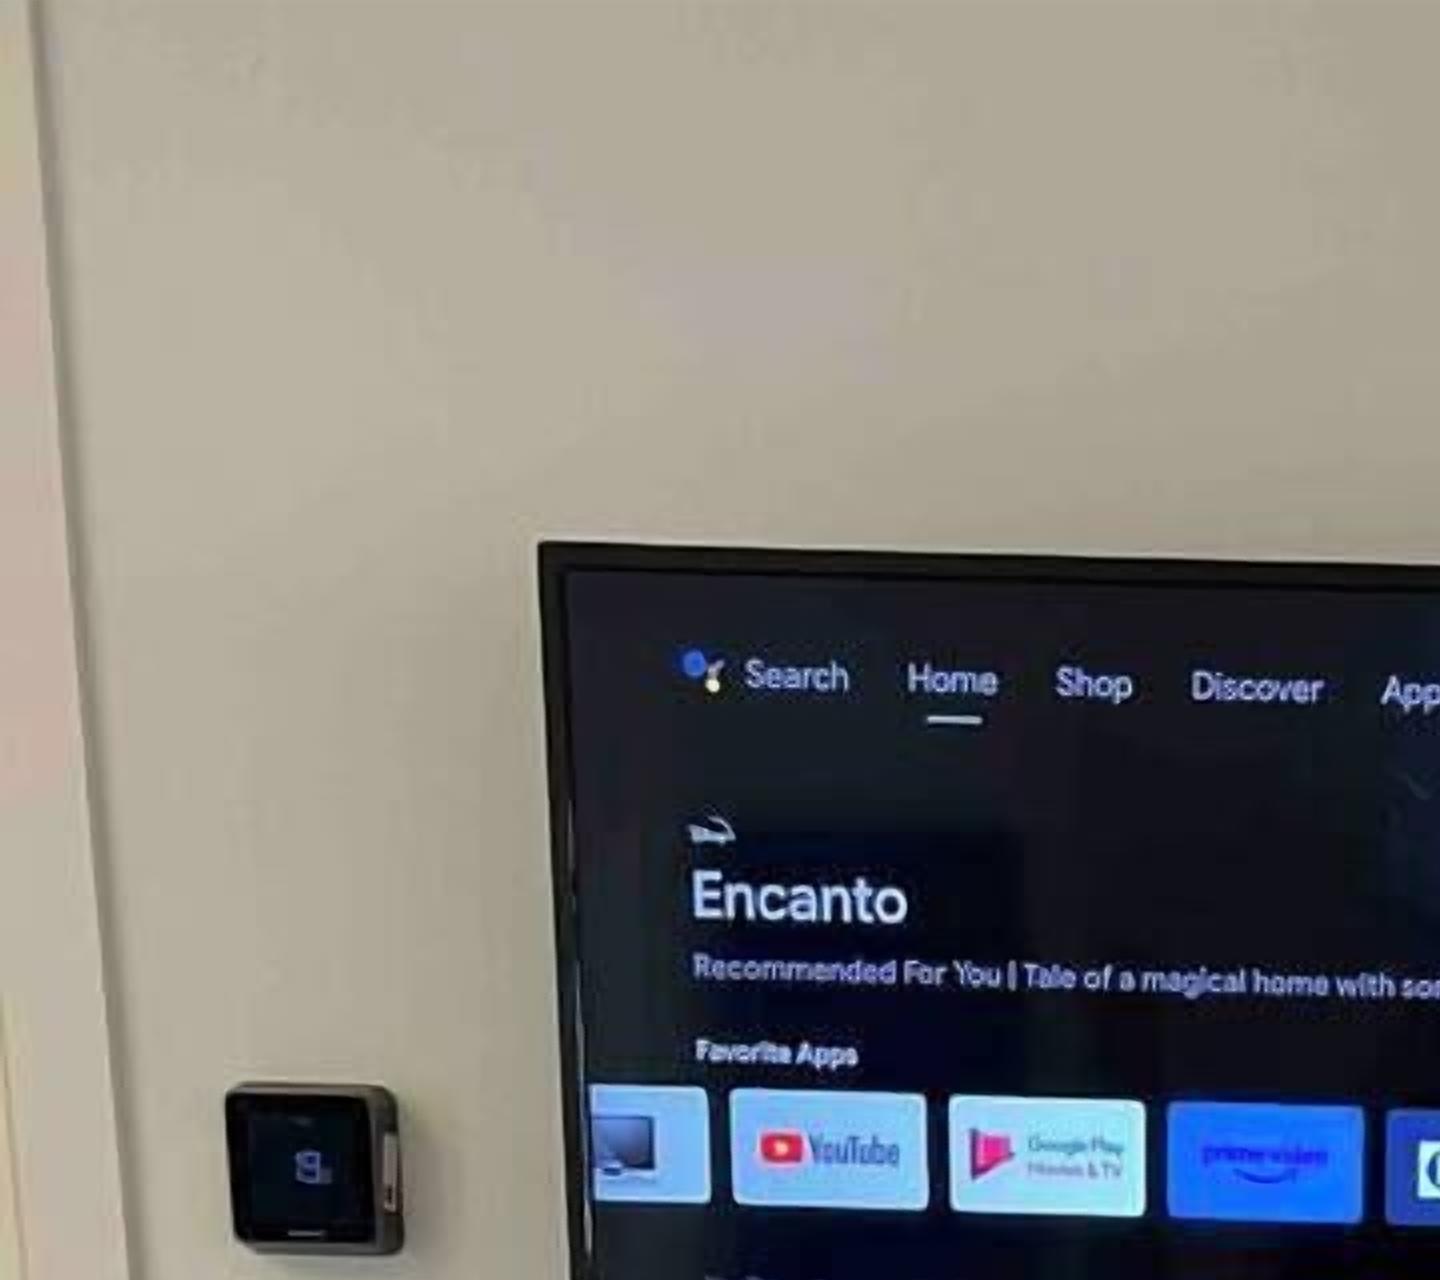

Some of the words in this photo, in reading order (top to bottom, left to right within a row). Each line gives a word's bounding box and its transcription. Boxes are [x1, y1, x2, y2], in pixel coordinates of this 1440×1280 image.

[744, 659, 850, 691] Search
[907, 662, 998, 696] Home
[1055, 665, 1133, 703] Shop
[1191, 671, 1325, 704] Discover
[692, 870, 908, 924] Encanto
[693, 953, 897, 985] Recommended
[904, 961, 945, 986] For
[952, 960, 1001, 988] You
[1024, 963, 1076, 989] Tale
[1083, 965, 1112, 991] of
[1119, 972, 1136, 991] a
[1142, 966, 1245, 1000] magical
[1253, 970, 1329, 996] home
[1335, 971, 1396, 998] with
[695, 1039, 792, 1066] Favorite
[795, 1041, 859, 1071] Apps
[808, 1133, 901, 1166] YouTube
